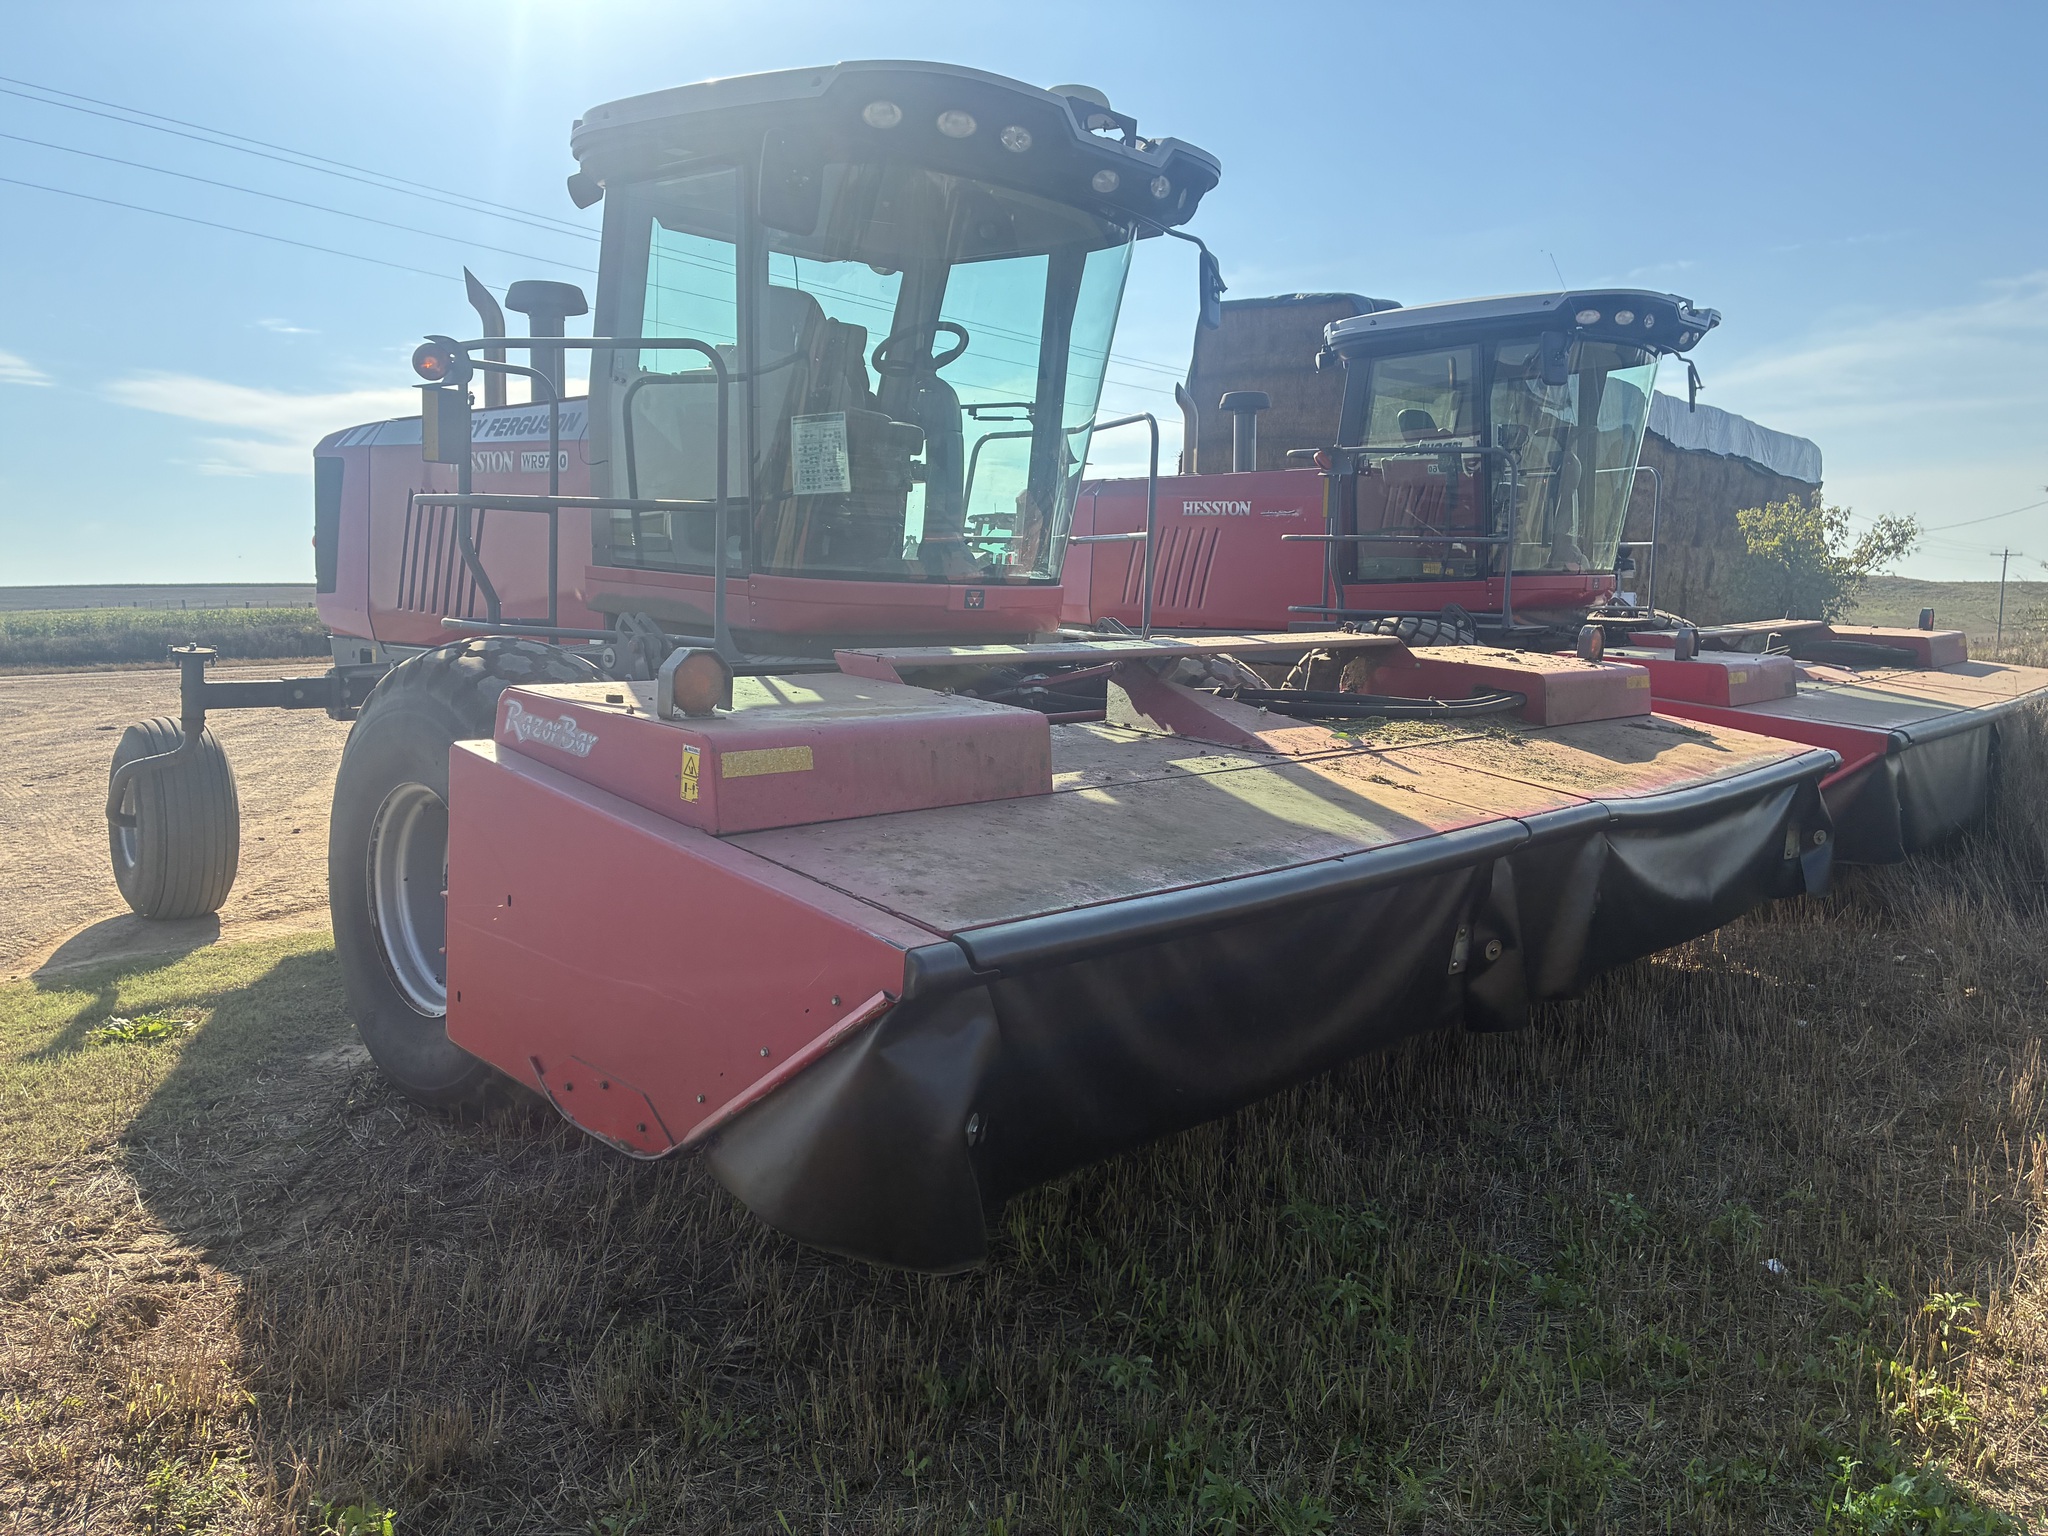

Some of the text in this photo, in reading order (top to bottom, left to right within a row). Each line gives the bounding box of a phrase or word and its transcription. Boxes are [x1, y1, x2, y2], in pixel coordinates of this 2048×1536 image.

[450, 451, 567, 474] SSTON WR970
[1182, 501, 1251, 516] HESSTON
